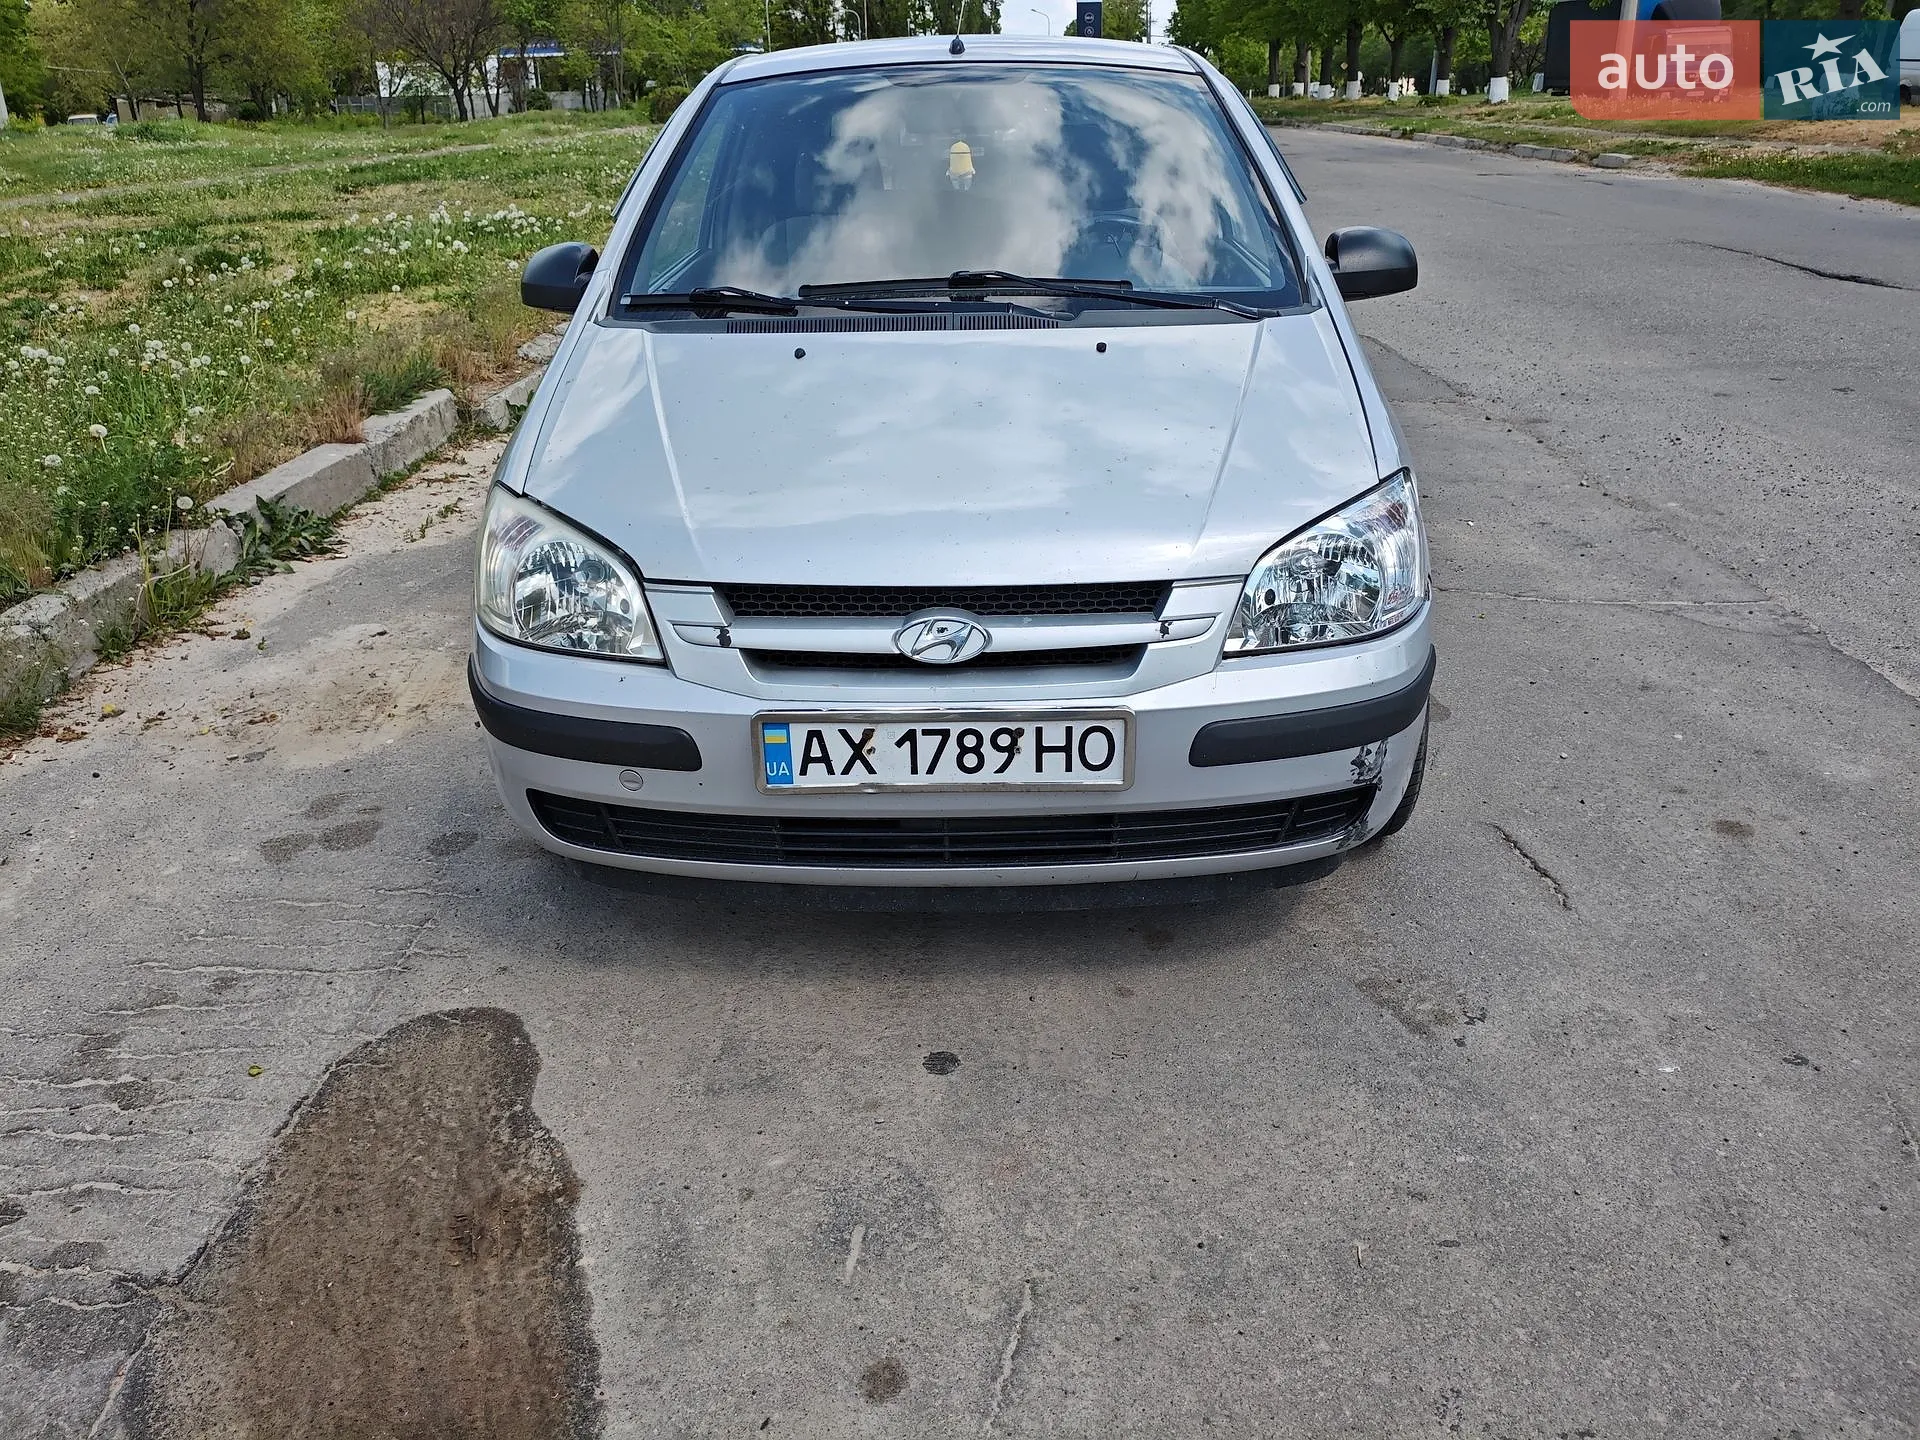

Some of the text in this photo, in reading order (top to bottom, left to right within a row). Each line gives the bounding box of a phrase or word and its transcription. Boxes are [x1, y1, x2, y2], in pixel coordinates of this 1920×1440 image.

[799, 725, 1116, 776] AX 1789 HO
[766, 761, 790, 776] UA
